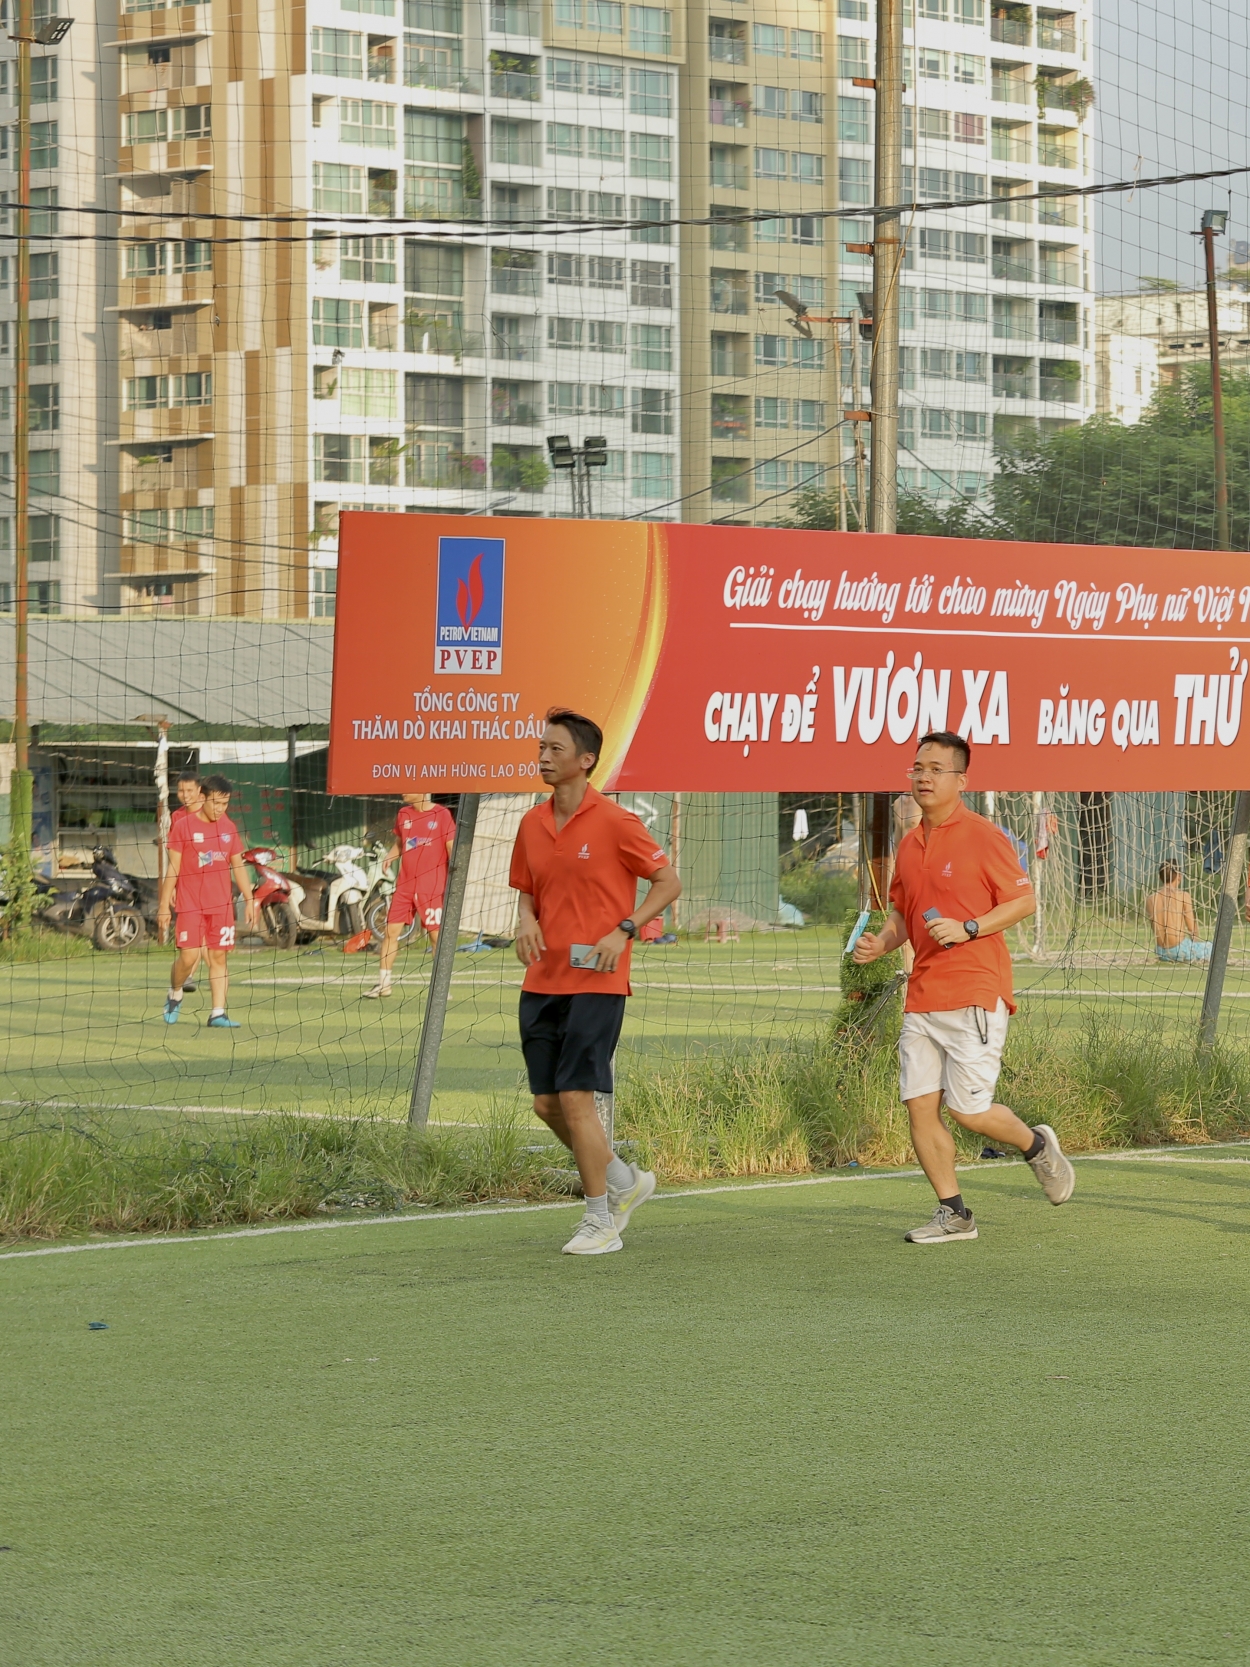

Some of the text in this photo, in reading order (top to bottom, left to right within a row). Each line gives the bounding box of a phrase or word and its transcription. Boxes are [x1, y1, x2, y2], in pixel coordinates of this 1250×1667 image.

[723, 565, 774, 610] Giải
[778, 568, 831, 621] chạy
[833, 570, 901, 624] hướng
[904, 574, 934, 614] tới
[938, 575, 986, 615] chào
[990, 579, 1049, 629] mừng
[1054, 579, 1110, 631] Ngày
[1115, 583, 1158, 630] Phụ
[1161, 588, 1192, 622] nữ
[1193, 585, 1235, 631] Việt
[440, 650, 498, 670] PVEP
[413, 685, 520, 712] TỔNG CÔNG TY
[704, 691, 779, 758] CHẠY
[781, 665, 821, 743] ĐỂ
[833, 650, 951, 745] VƯƠN
[957, 669, 1010, 745] XA
[1037, 683, 1106, 745] BĂNG
[1111, 699, 1160, 752] QUA
[1174, 646, 1249, 747] THỬ
[352, 713, 546, 740] THĂM DÒ KHAI THÁC DẦU
[372, 763, 400, 778] ĐƠN
[405, 764, 416, 780] VỊ
[421, 764, 447, 778] ANH
[451, 762, 486, 778] HÙNG
[490, 764, 514, 777] LAO
